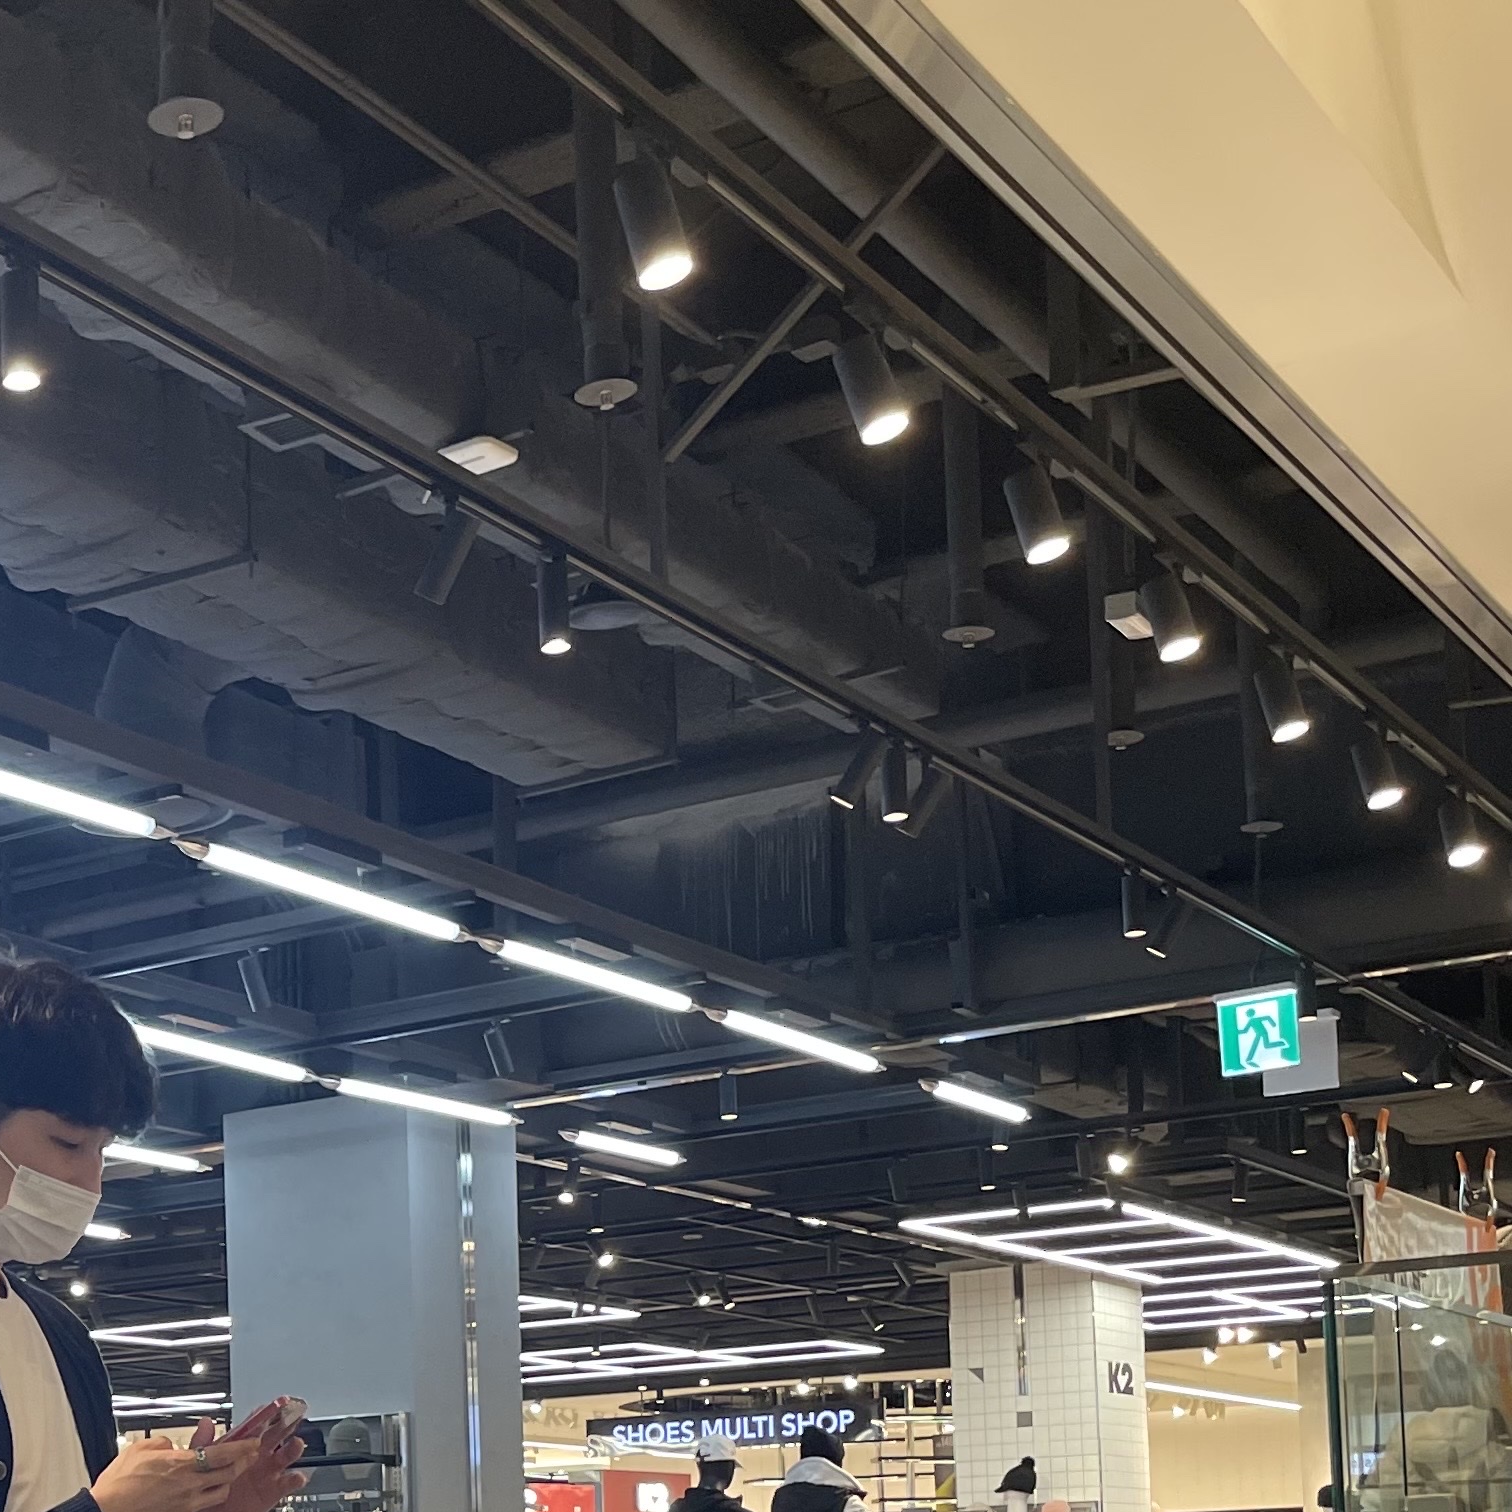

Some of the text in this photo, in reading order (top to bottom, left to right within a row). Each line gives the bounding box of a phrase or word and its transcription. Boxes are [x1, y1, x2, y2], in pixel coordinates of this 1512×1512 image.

[1108, 1361, 1134, 1396] K2
[612, 1410, 855, 1446] SHOES MULTI SHOP
